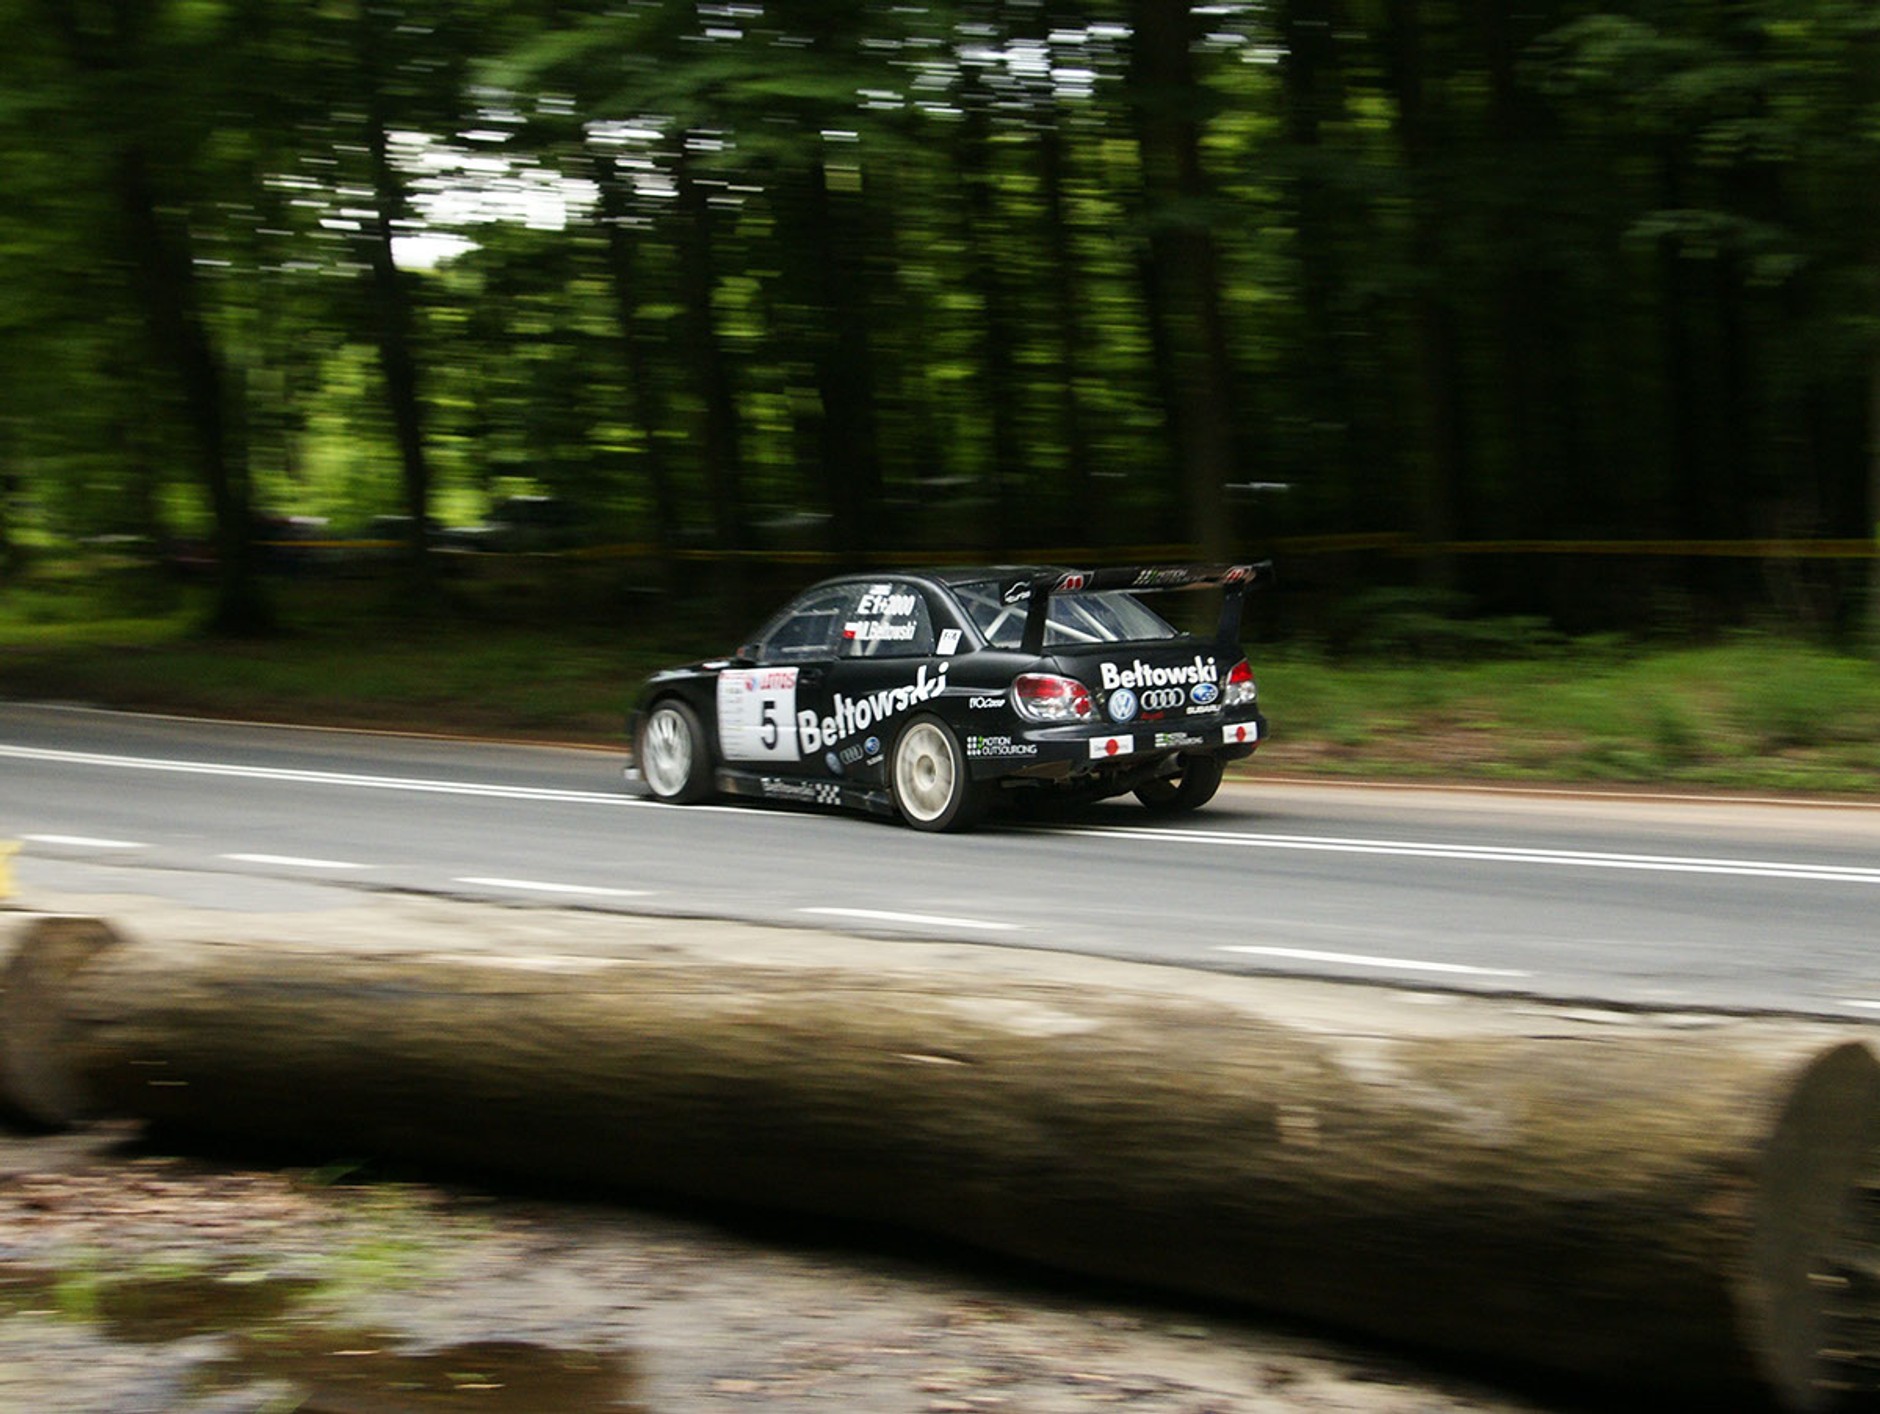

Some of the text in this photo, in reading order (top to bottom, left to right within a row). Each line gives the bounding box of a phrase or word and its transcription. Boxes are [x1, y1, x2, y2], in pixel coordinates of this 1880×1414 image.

[1185, 704, 1222, 715] SUBARU
[760, 700, 778, 751] 5
[982, 736, 1012, 745] MOTION
[981, 744, 1039, 755] OUTSOURCING
